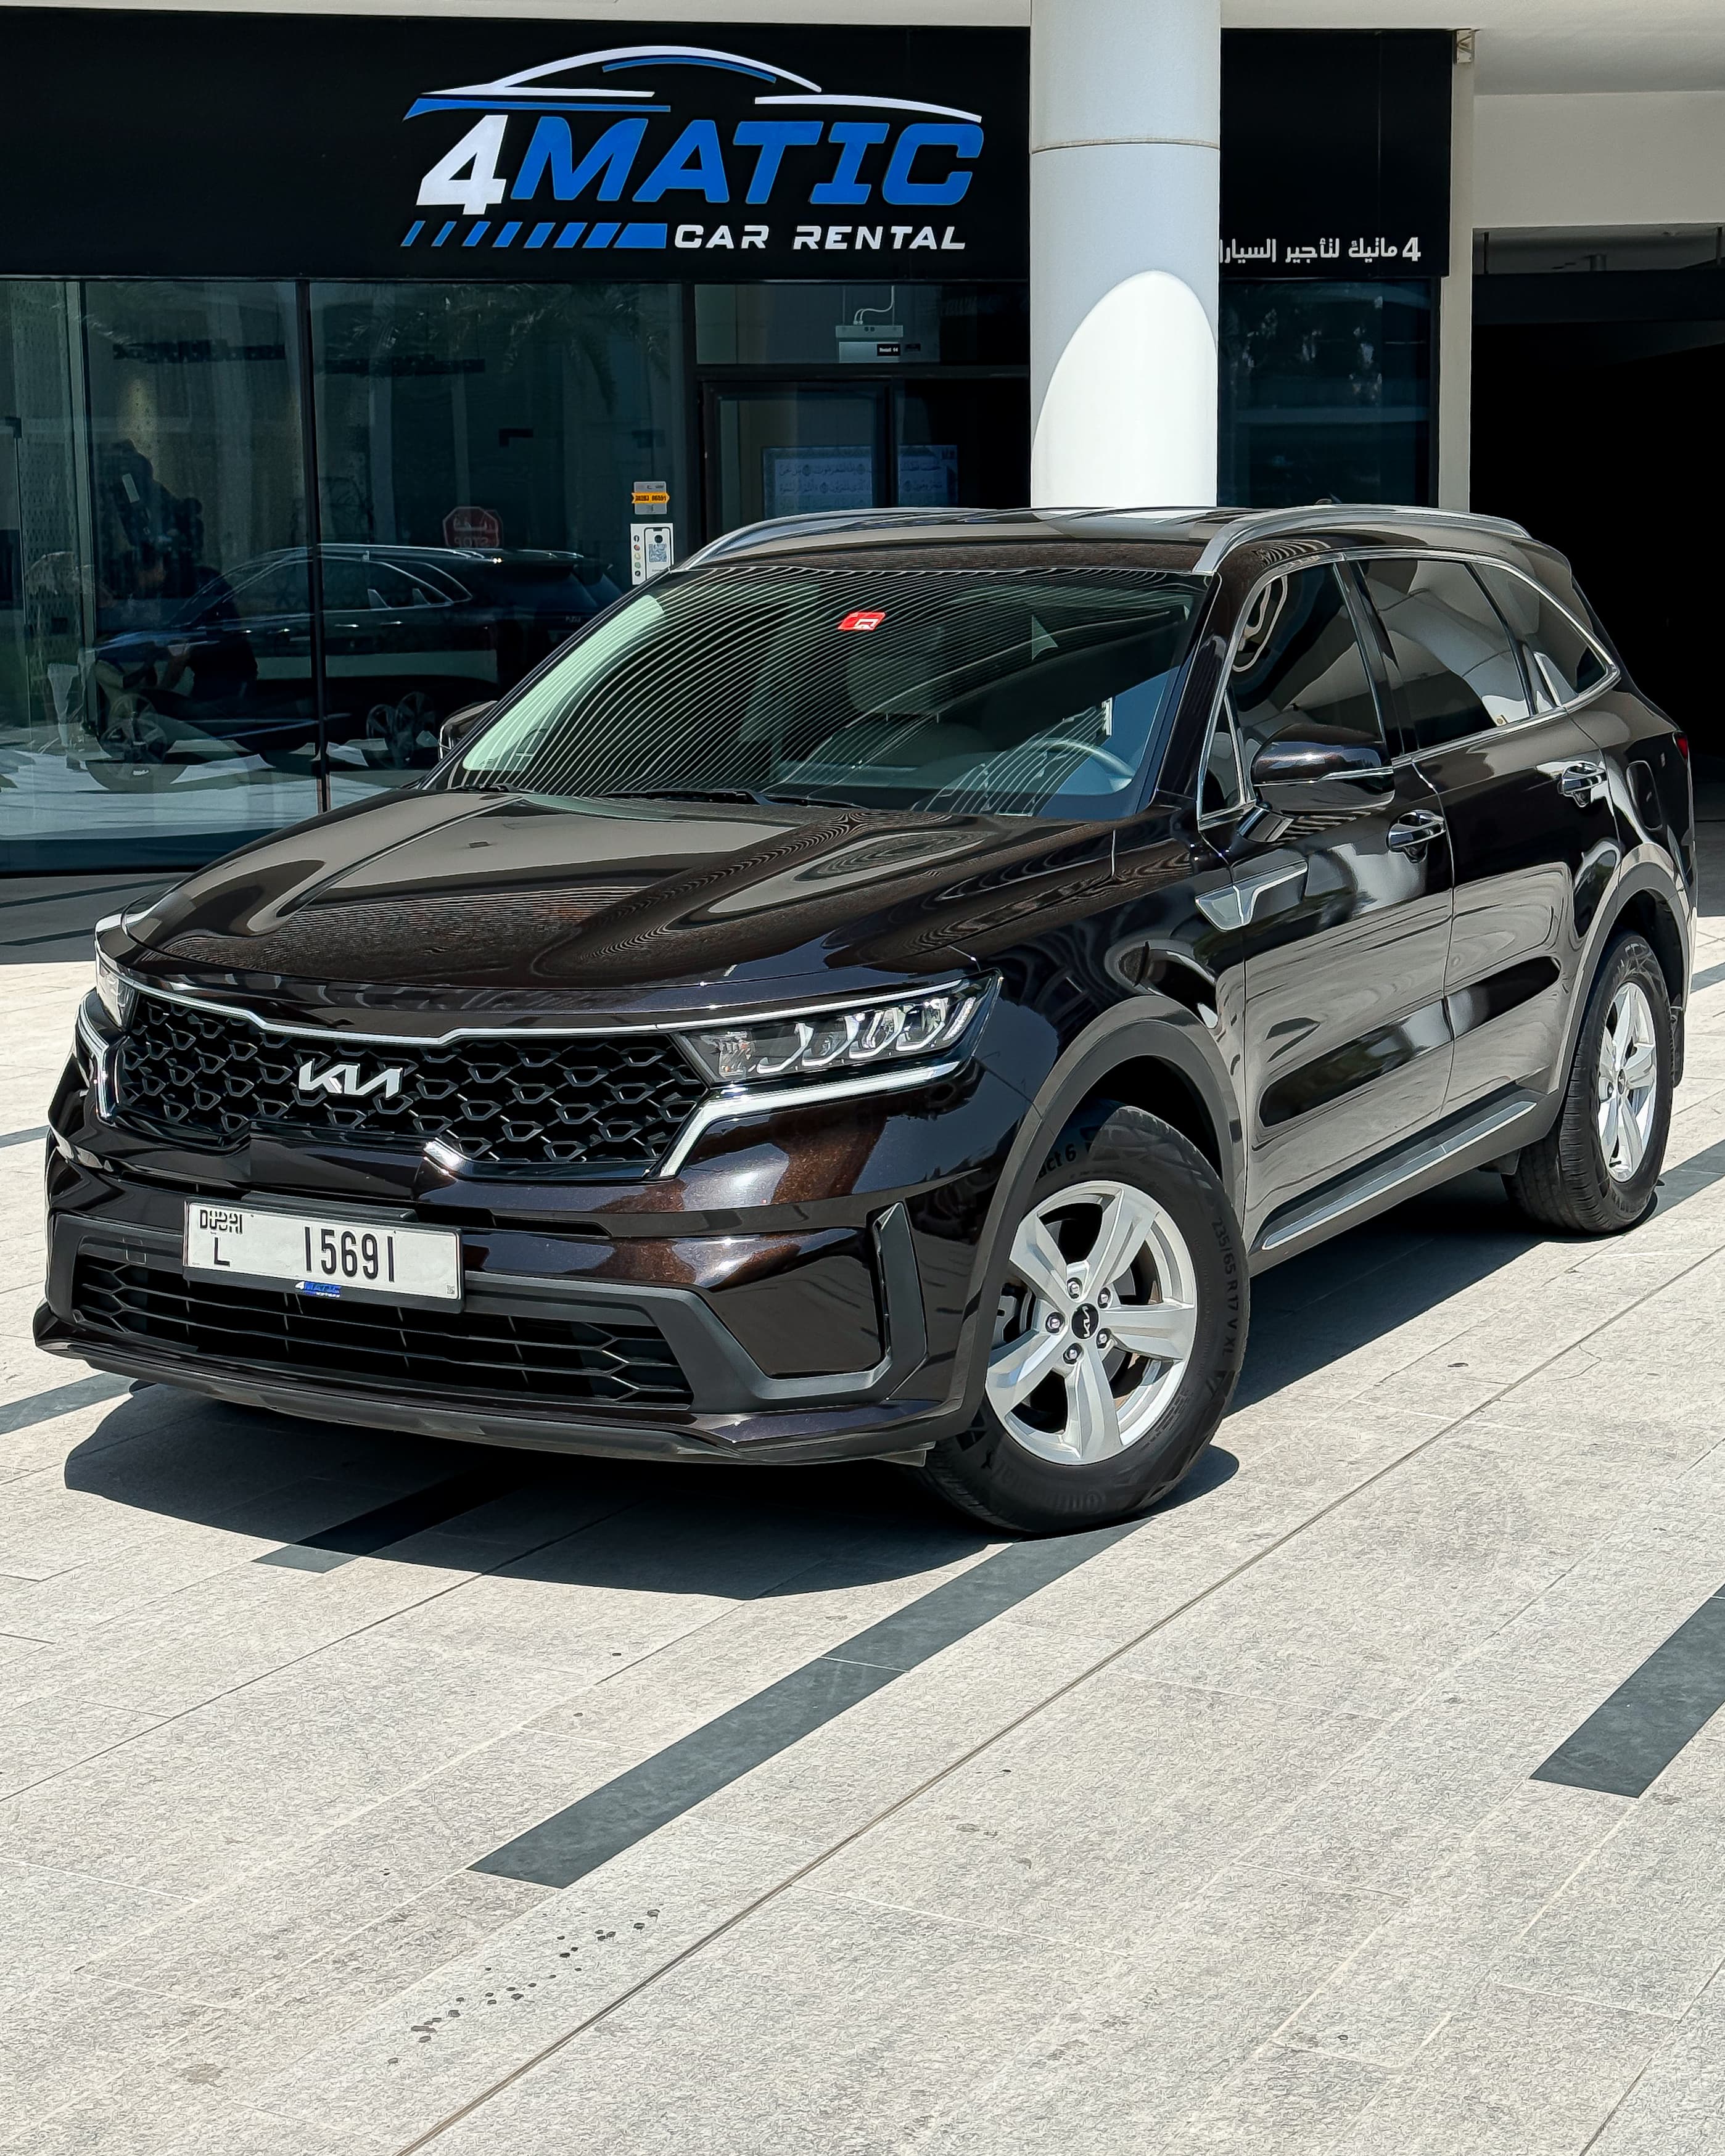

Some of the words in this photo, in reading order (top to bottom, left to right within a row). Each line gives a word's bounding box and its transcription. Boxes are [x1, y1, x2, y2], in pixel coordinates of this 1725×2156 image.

[416, 114, 984, 215] 4MATIC
[674, 224, 769, 249] CAR
[793, 225, 966, 250] RENTAL
[1285, 237, 1340, 263] لتأجير
[1348, 237, 1398, 263] ماتيك
[1402, 237, 1422, 261] 4
[1219, 238, 1277, 263] السيارا
[298, 1059, 403, 1098] KIA
[1065, 1143, 1076, 1162] 6
[214, 1237, 231, 1268] L
[304, 1226, 395, 1283] 15691
[1211, 1217, 1237, 1275] 235/65
[1227, 1319, 1238, 1330] V
